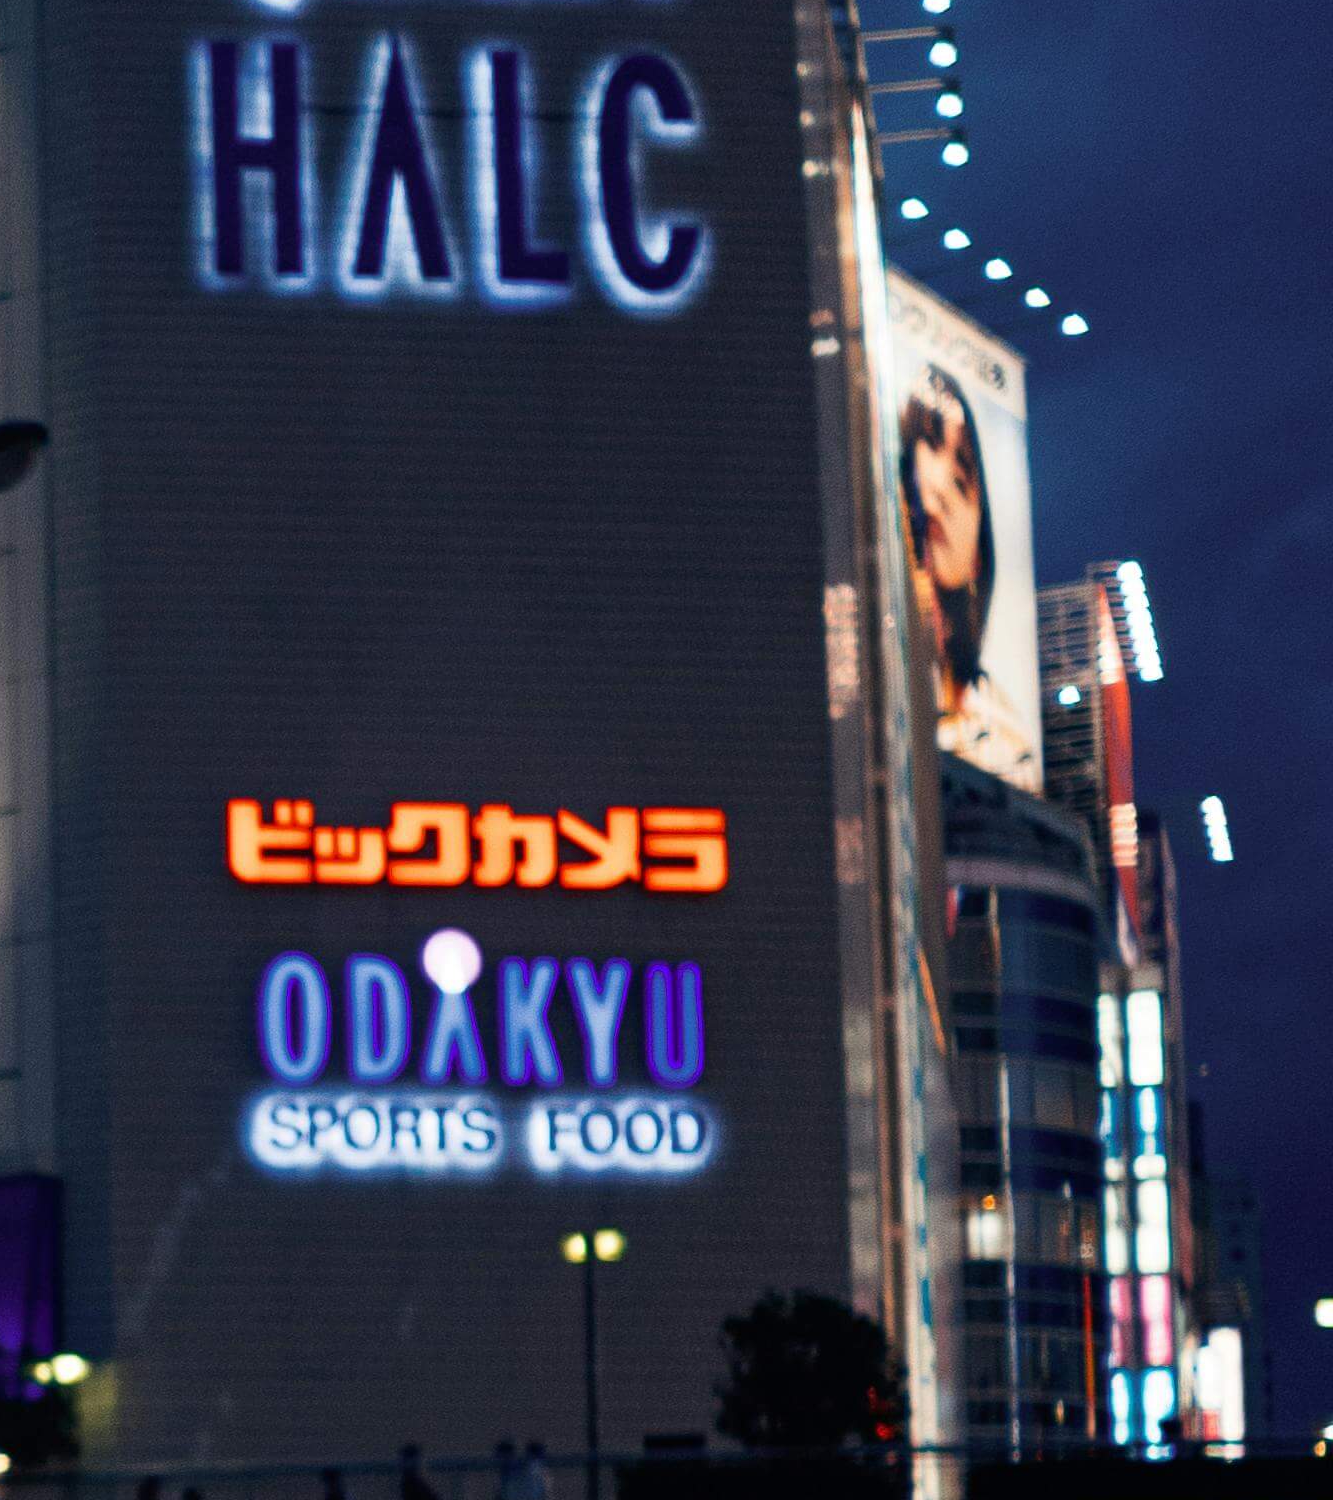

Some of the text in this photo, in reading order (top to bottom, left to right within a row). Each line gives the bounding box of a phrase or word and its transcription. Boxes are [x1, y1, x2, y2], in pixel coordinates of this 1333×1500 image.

[199, 30, 707, 302] HALC
[227, 799, 729, 893] ビックカメラ
[258, 930, 705, 1089] ODAKYU
[261, 1098, 713, 1162] SPORTS FOOD
